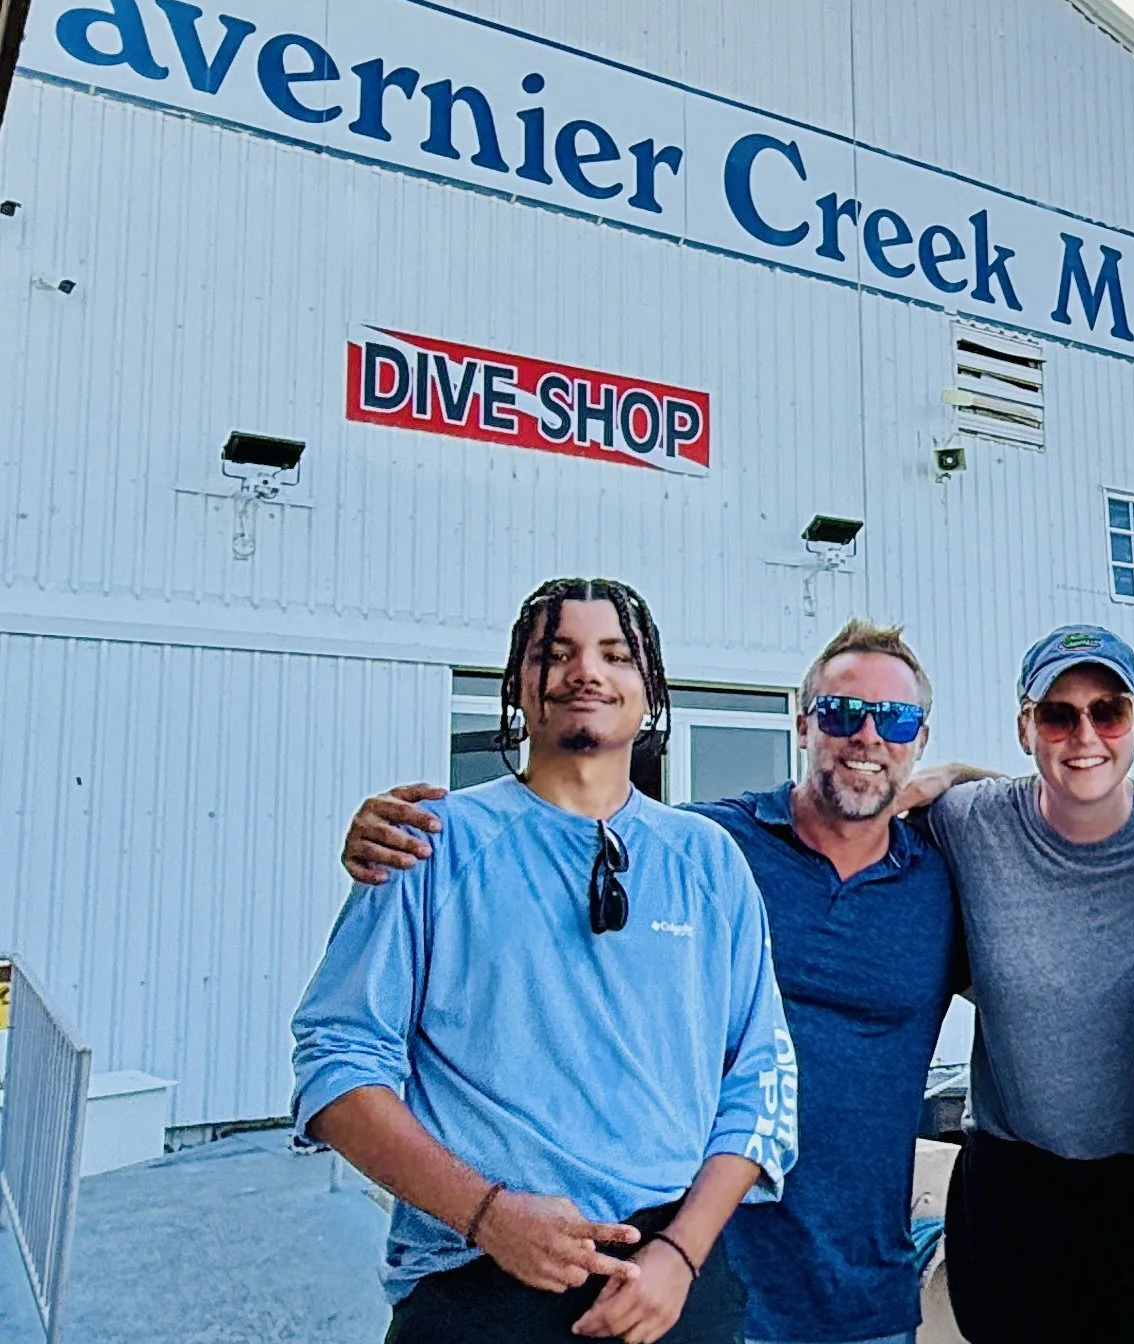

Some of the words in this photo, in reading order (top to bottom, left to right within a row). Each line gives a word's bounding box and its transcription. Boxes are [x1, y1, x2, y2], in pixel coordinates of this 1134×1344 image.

[723, 133, 1023, 312] Creek
[363, 341, 517, 431] DIVE
[538, 375, 700, 458] SHOP
